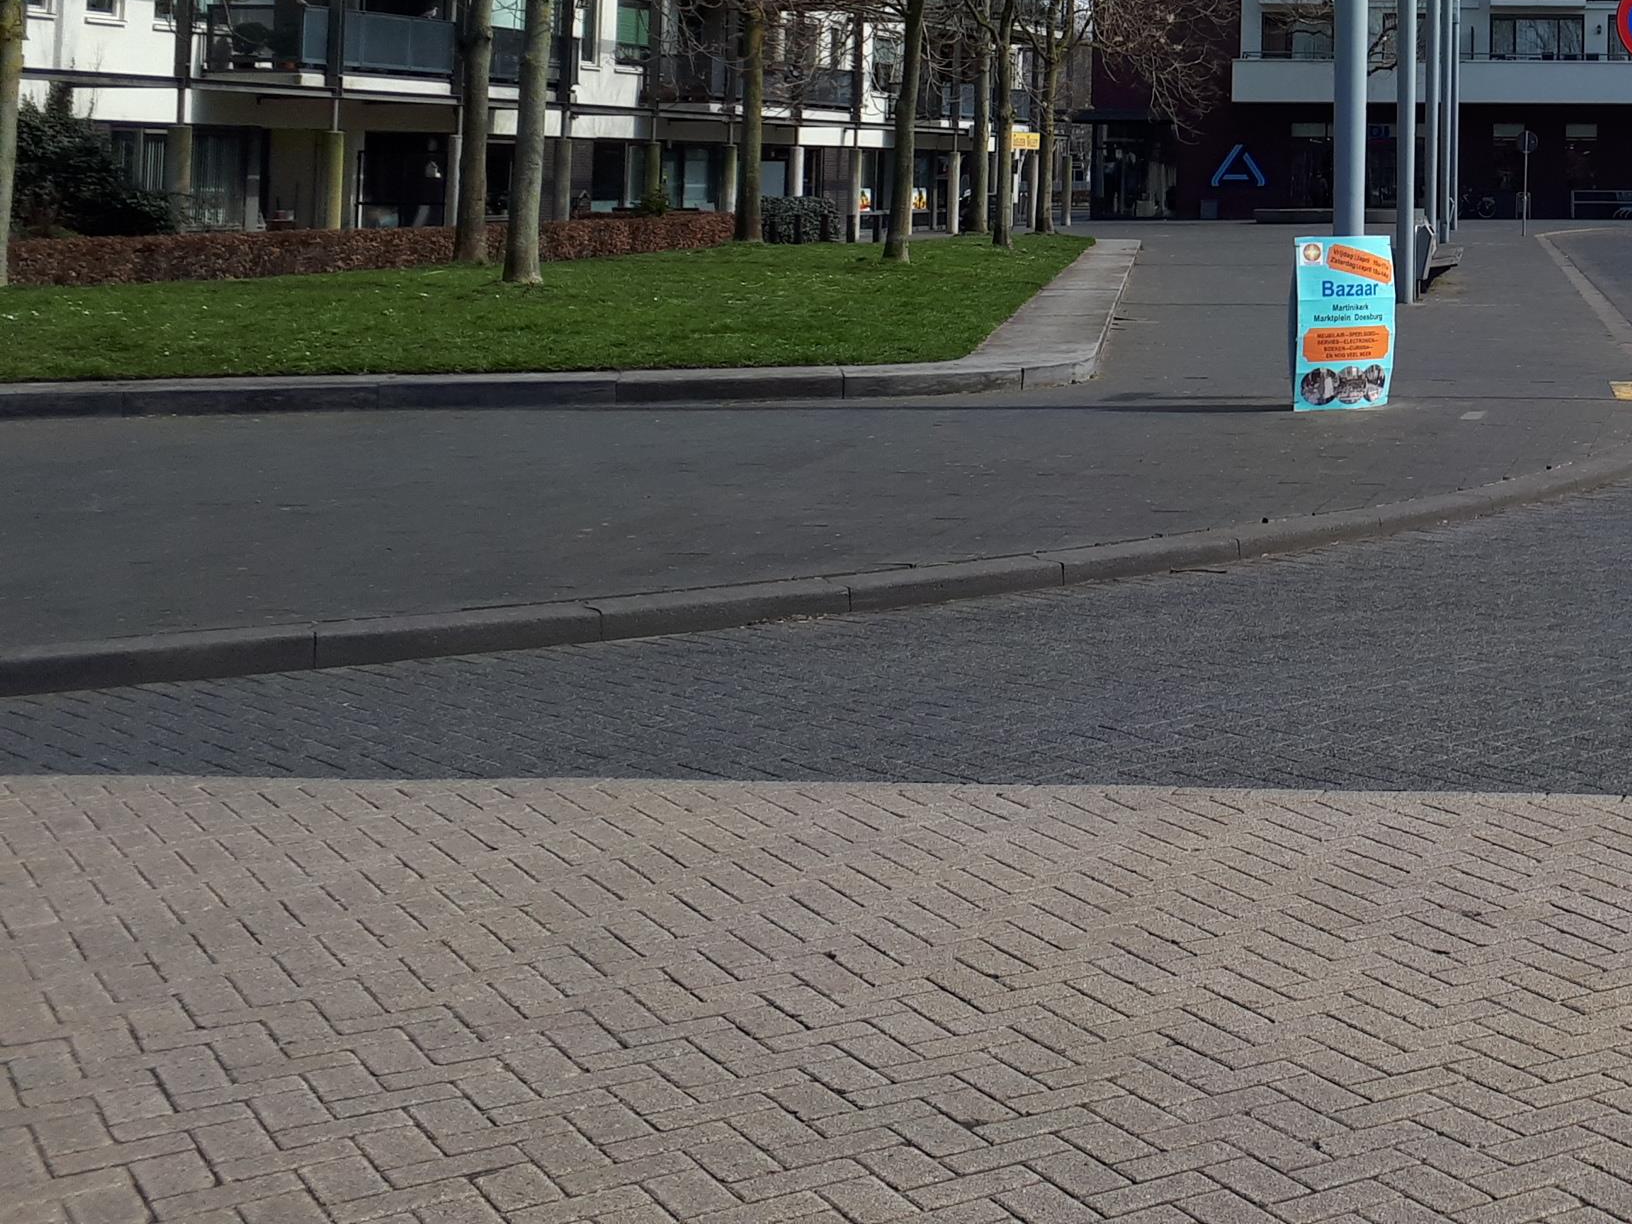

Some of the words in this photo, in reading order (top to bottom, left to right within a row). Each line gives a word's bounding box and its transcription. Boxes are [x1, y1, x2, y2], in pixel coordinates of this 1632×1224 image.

[1322, 280, 1379, 297] Bazaar
[1332, 303, 1369, 312] Martinikerk
[1313, 314, 1351, 323] Marktplein
[1354, 313, 1383, 322] Doesburg
